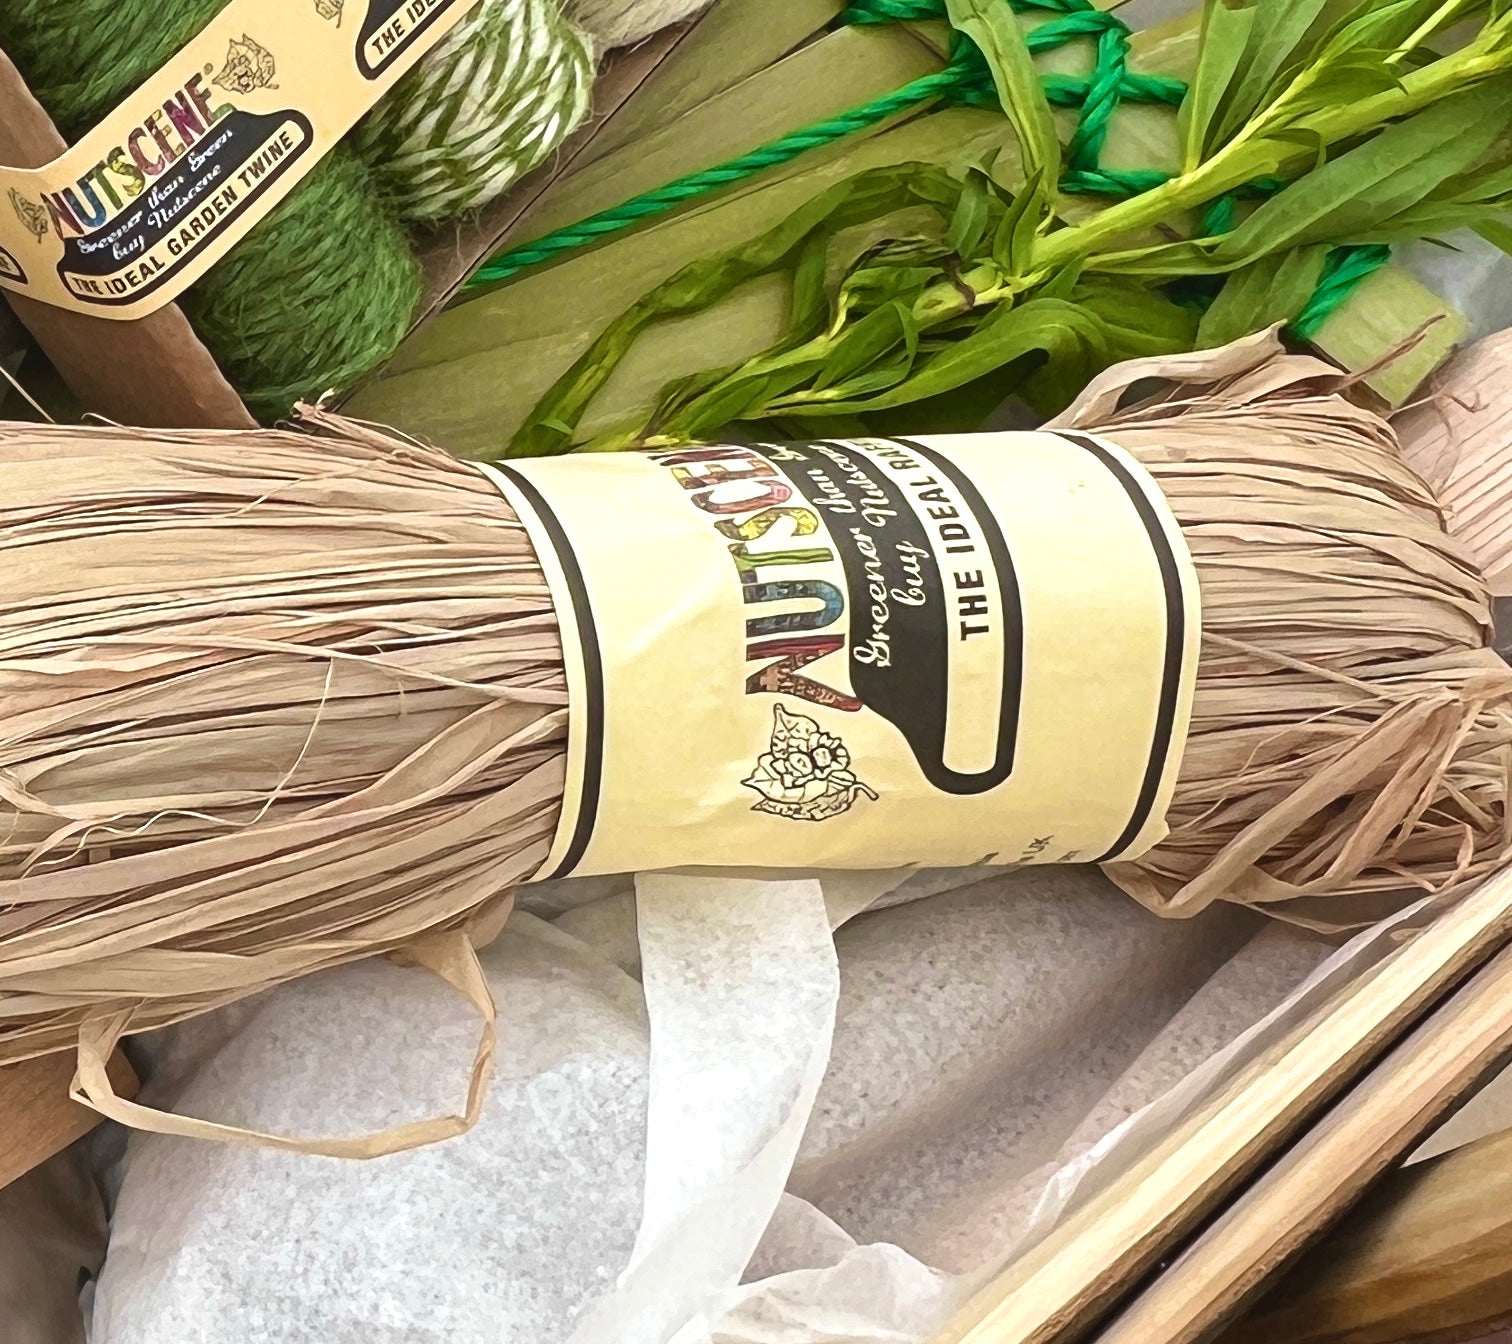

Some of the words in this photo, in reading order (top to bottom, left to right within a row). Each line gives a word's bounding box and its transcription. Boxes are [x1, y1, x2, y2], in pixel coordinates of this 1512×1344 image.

[371, 18, 406, 55] THE
[40, 72, 238, 240] NUTSCENE
[72, 275, 104, 296] THE
[104, 255, 166, 296] IDEAL
[167, 186, 239, 256] GARDEN
[238, 130, 294, 189] TWINE
[807, 468, 858, 514] than
[908, 474, 976, 555] IDEAL
[646, 447, 863, 713] NUTSCEN
[849, 526, 893, 668] Greener
[890, 539, 931, 607] buy
[952, 568, 990, 642] THE
